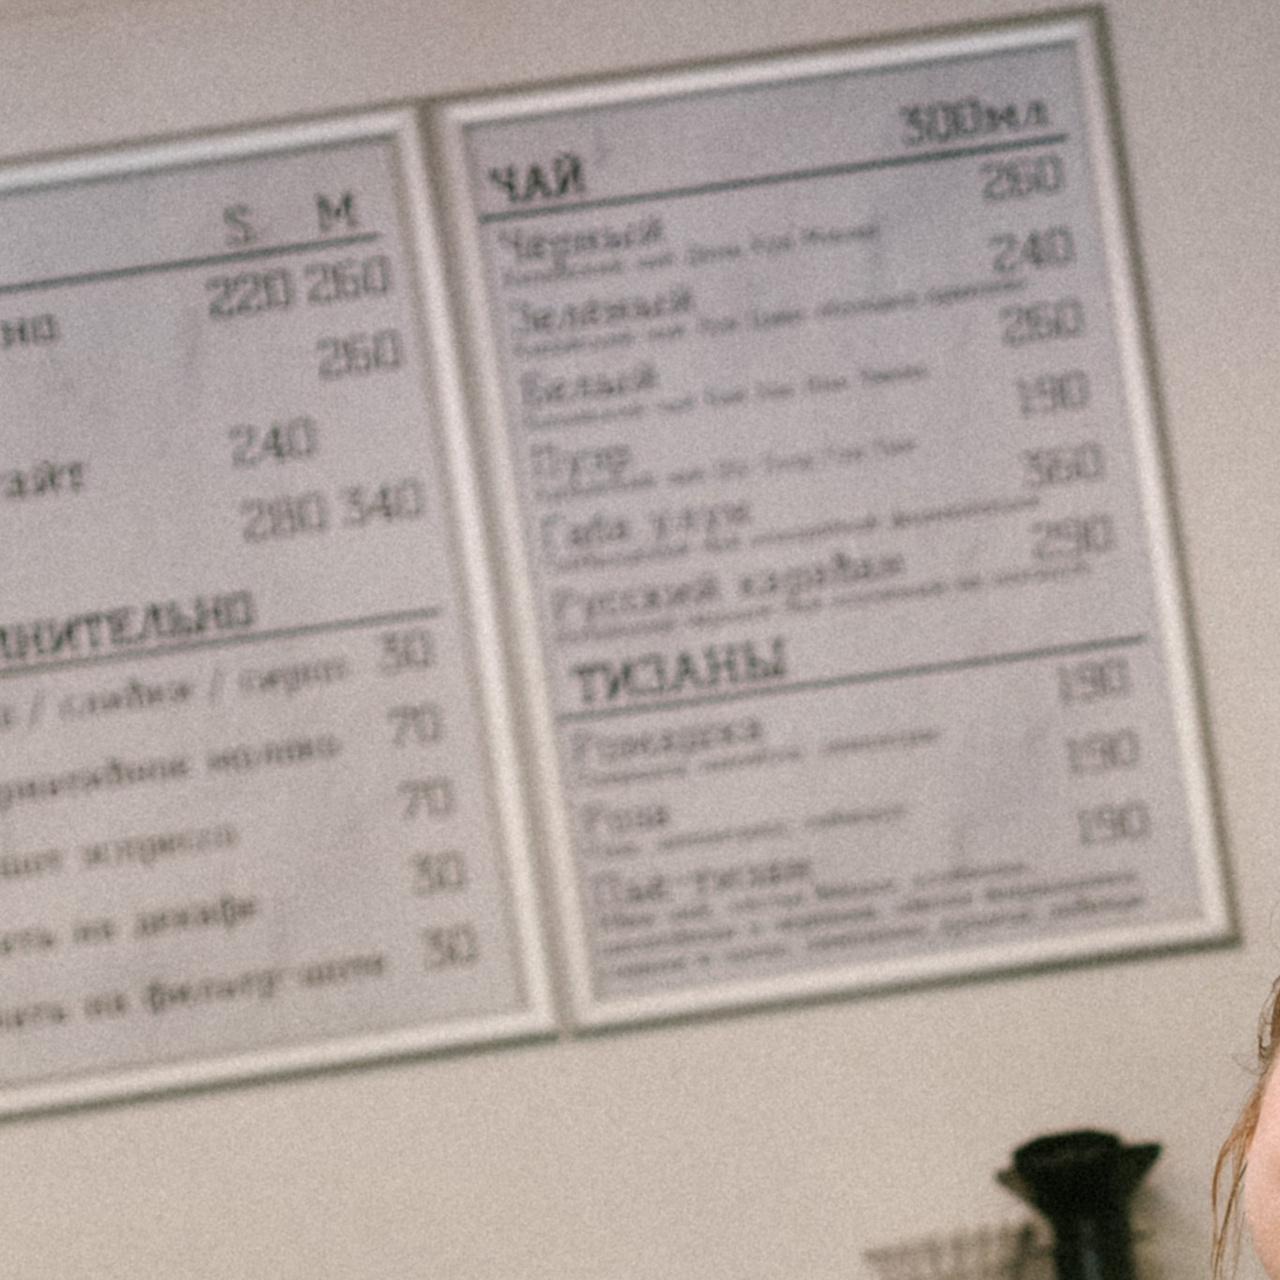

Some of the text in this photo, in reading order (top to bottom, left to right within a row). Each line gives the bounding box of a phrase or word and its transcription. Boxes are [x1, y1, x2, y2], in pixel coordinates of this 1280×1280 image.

[487, 151, 588, 204] ЧАЙ
[222, 190, 359, 245] S M
[989, 225, 1077, 276] 240
[206, 254, 393, 321] 220 260
[316, 327, 404, 380] 260
[228, 416, 318, 468] 240
[570, 636, 789, 704] ТИЗАНЫ
[386, 701, 447, 747] 70
[397, 774, 457, 820] 70
